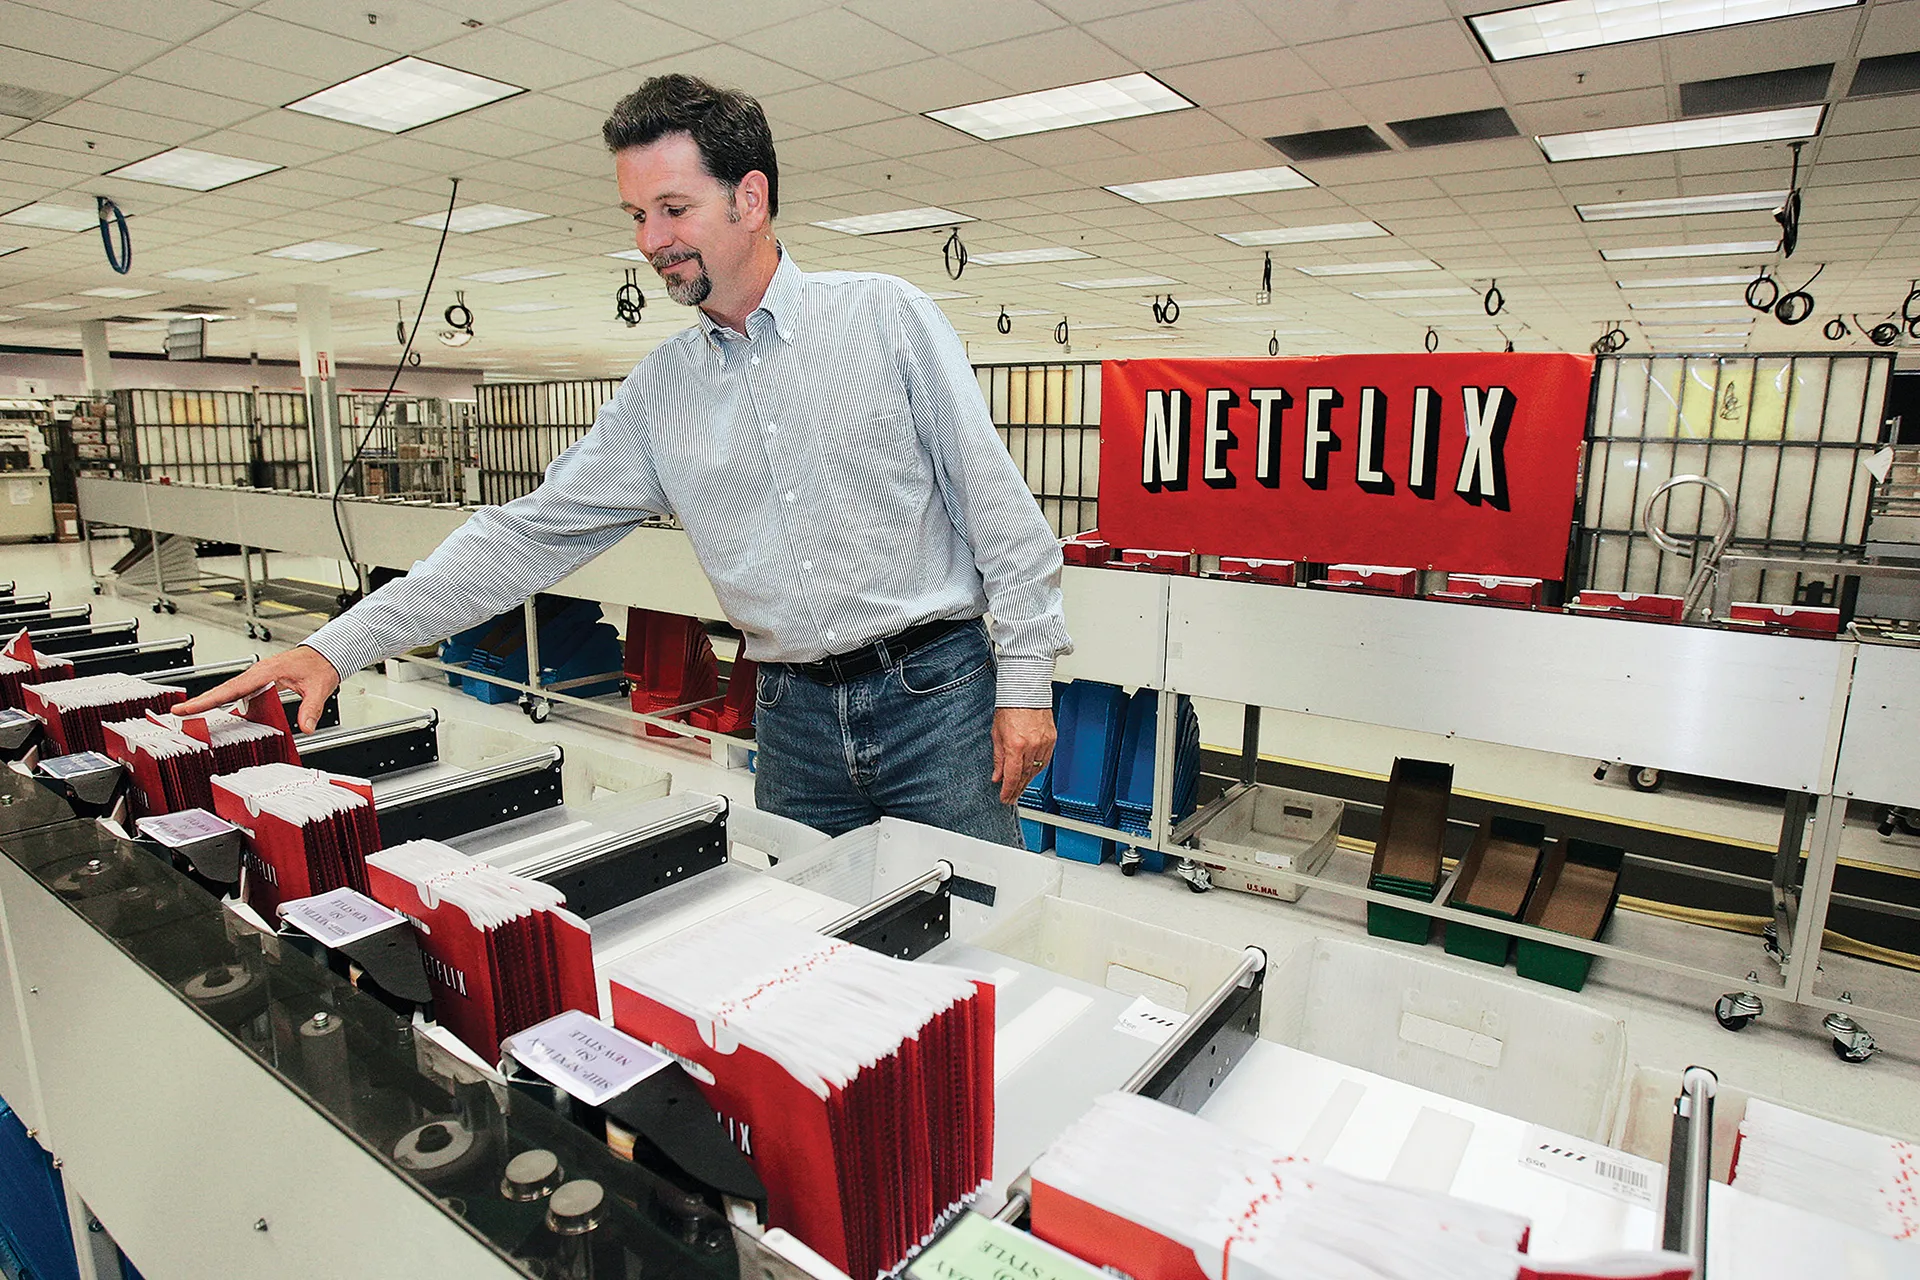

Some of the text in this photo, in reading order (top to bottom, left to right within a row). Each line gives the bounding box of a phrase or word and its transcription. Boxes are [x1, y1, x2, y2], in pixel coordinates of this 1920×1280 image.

[1142, 386, 1516, 511] NETFLIX
[423, 952, 467, 998] ETFLIX
[567, 1029, 632, 1068] NEW STYLE
[976, 1240, 1045, 1279] STYLE
